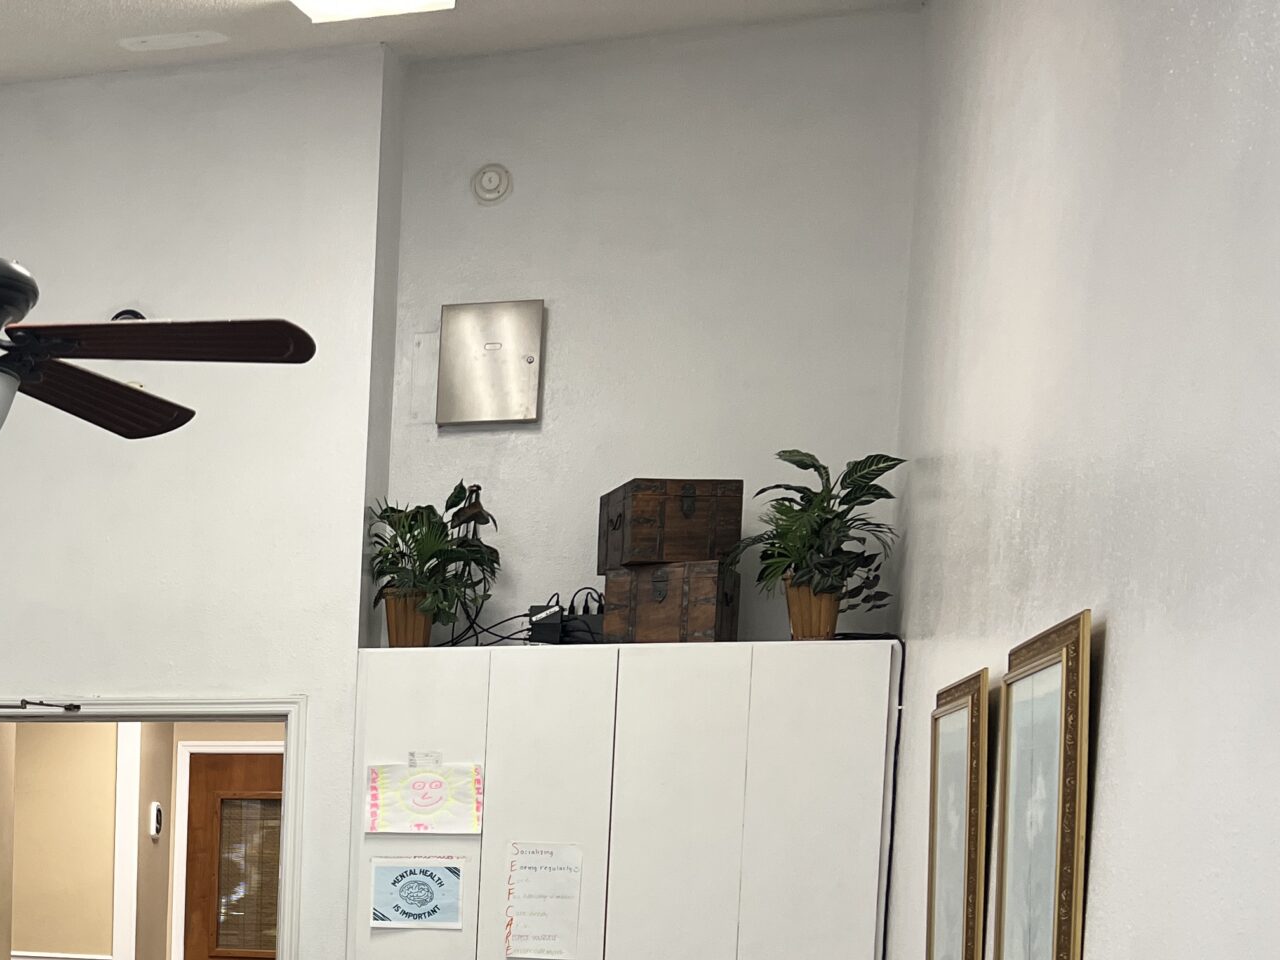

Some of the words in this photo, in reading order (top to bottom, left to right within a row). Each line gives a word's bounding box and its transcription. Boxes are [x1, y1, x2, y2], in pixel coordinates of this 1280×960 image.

[391, 868, 418, 887] MENTAL
[419, 868, 444, 888] HEALTH
[392, 903, 401, 912] IS
[399, 904, 440, 920] IMPORTANT
